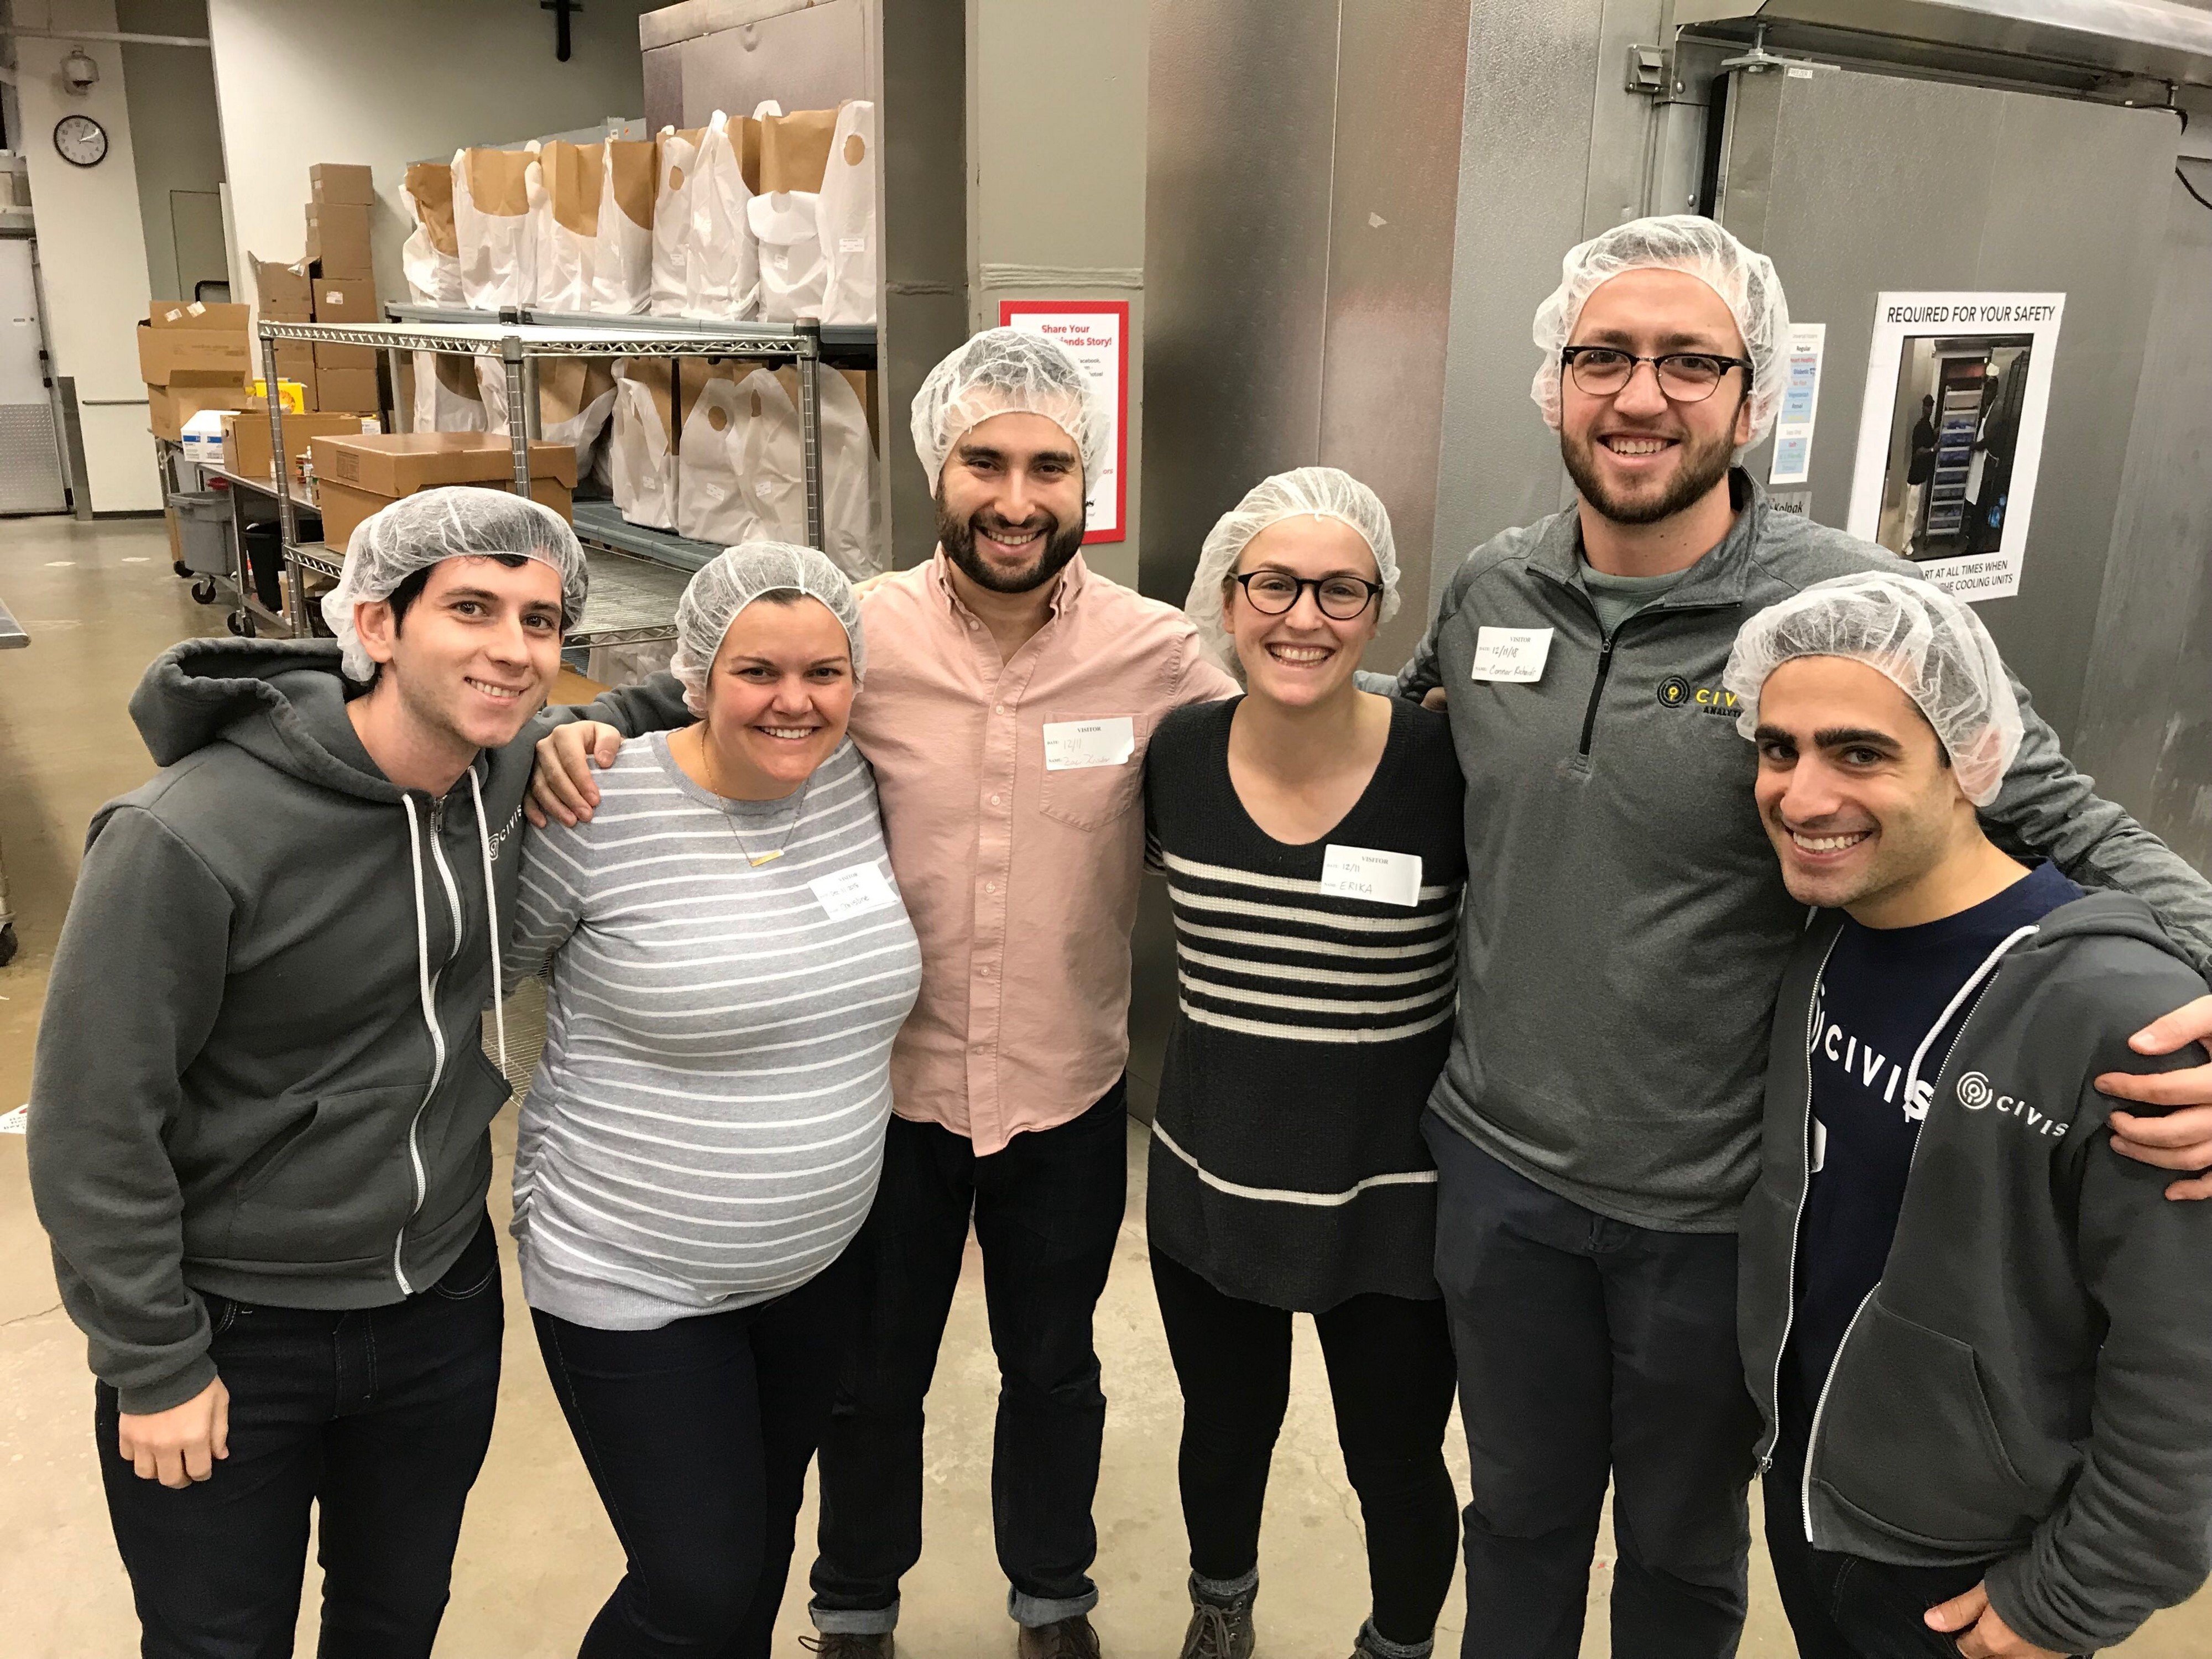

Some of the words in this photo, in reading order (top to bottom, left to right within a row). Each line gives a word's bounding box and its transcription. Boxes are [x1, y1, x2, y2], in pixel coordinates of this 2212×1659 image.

[1887, 306, 1949, 322] REQUIRED
[1952, 306, 1976, 322] FOR
[1980, 306, 2012, 321] YOUR
[2013, 306, 2056, 321] SAFETY
[1042, 325, 1067, 333] Share
[1069, 325, 1090, 333] Your
[1086, 337, 1112, 347] Story!
[1924, 569, 1934, 580] RT
[1935, 568, 1945, 579] AT
[1945, 566, 1959, 577] ALL
[1961, 563, 1984, 575] TIMES
[1985, 560, 2008, 572] WHEN
[1955, 576, 1991, 591] COOLING
[1991, 573, 2013, 586] UNITS
[1695, 689, 1738, 707] CIV
[1063, 738, 1082, 752] 12/11
[1342, 863, 1360, 873] 12/11
[1361, 856, 1389, 865] VISITOR
[1339, 881, 1372, 895] ERIKA
[1825, 1024, 1935, 1121] CIVIS
[1996, 1095, 2070, 1137] CIVIS
